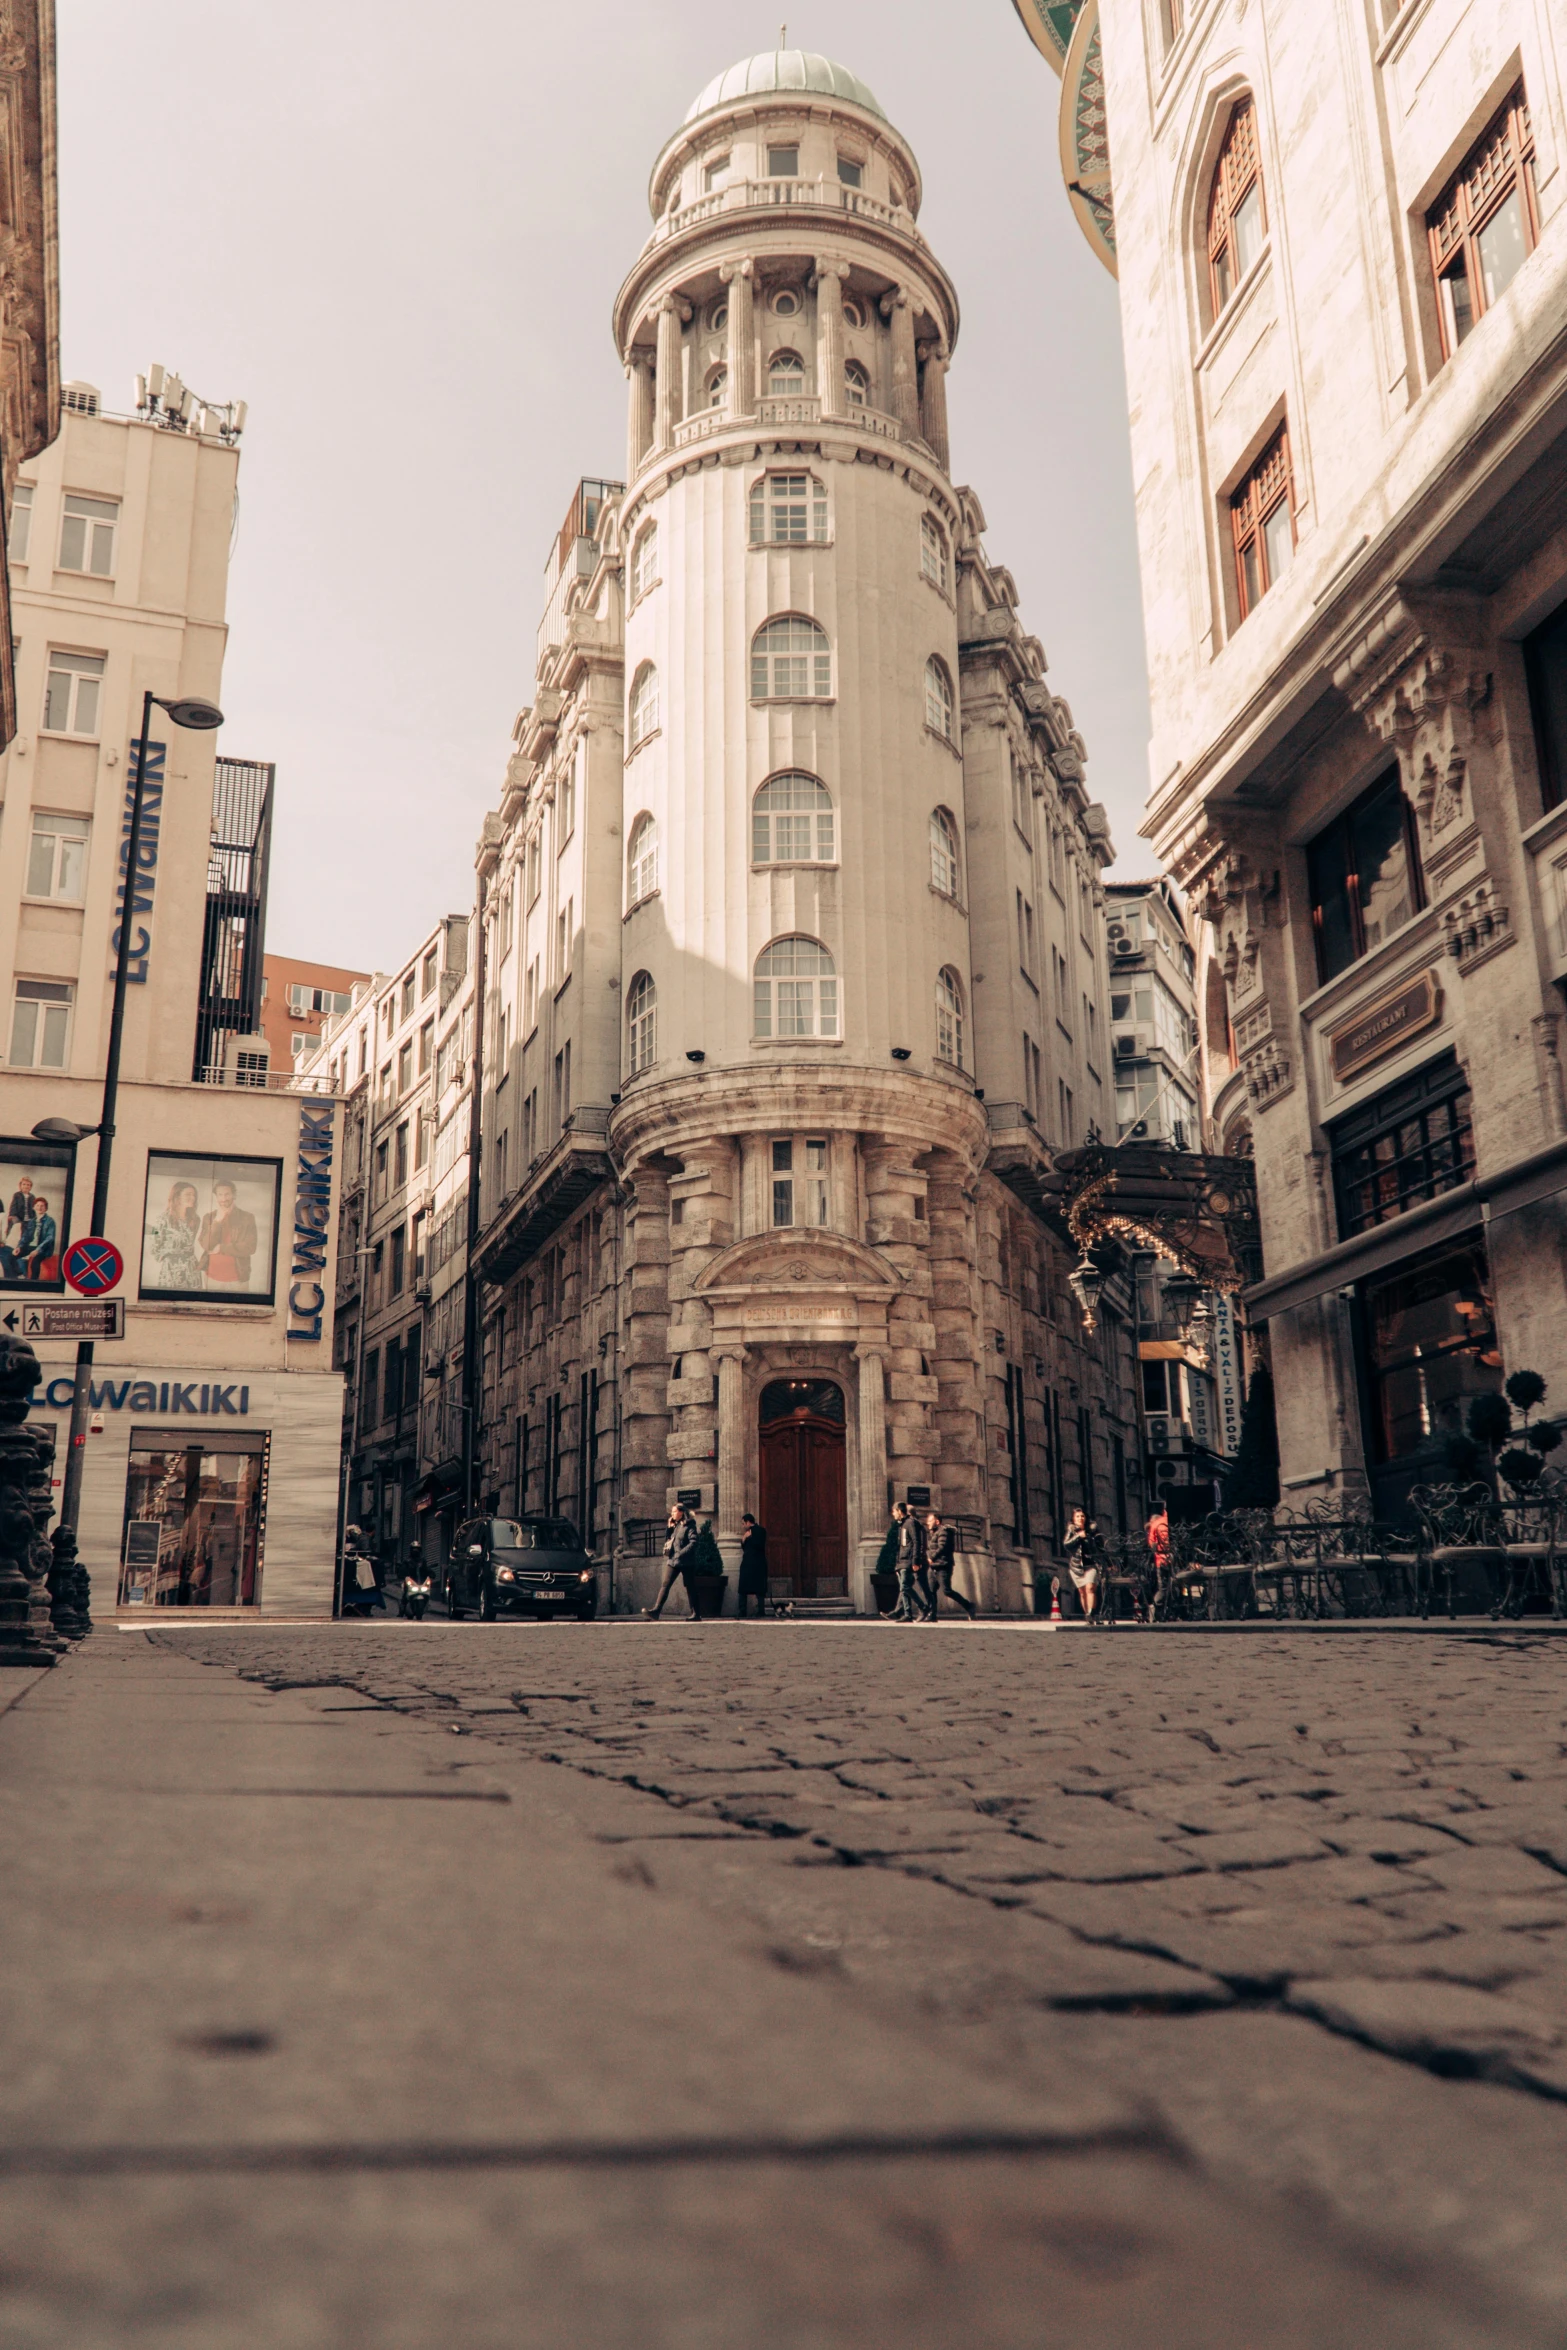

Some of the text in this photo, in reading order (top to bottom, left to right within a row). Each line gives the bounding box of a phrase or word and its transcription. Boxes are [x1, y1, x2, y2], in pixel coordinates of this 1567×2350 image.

[1351, 1005, 1407, 1050] RESTAURANT
[44, 1307, 114, 1319] Postane müzesi
[287, 1282, 325, 1341] LC
[50, 1322, 112, 1332] (Post Office Museum)
[1220, 1338, 1230, 1347] &
[1224, 1398, 1238, 1452] DEPOSU
